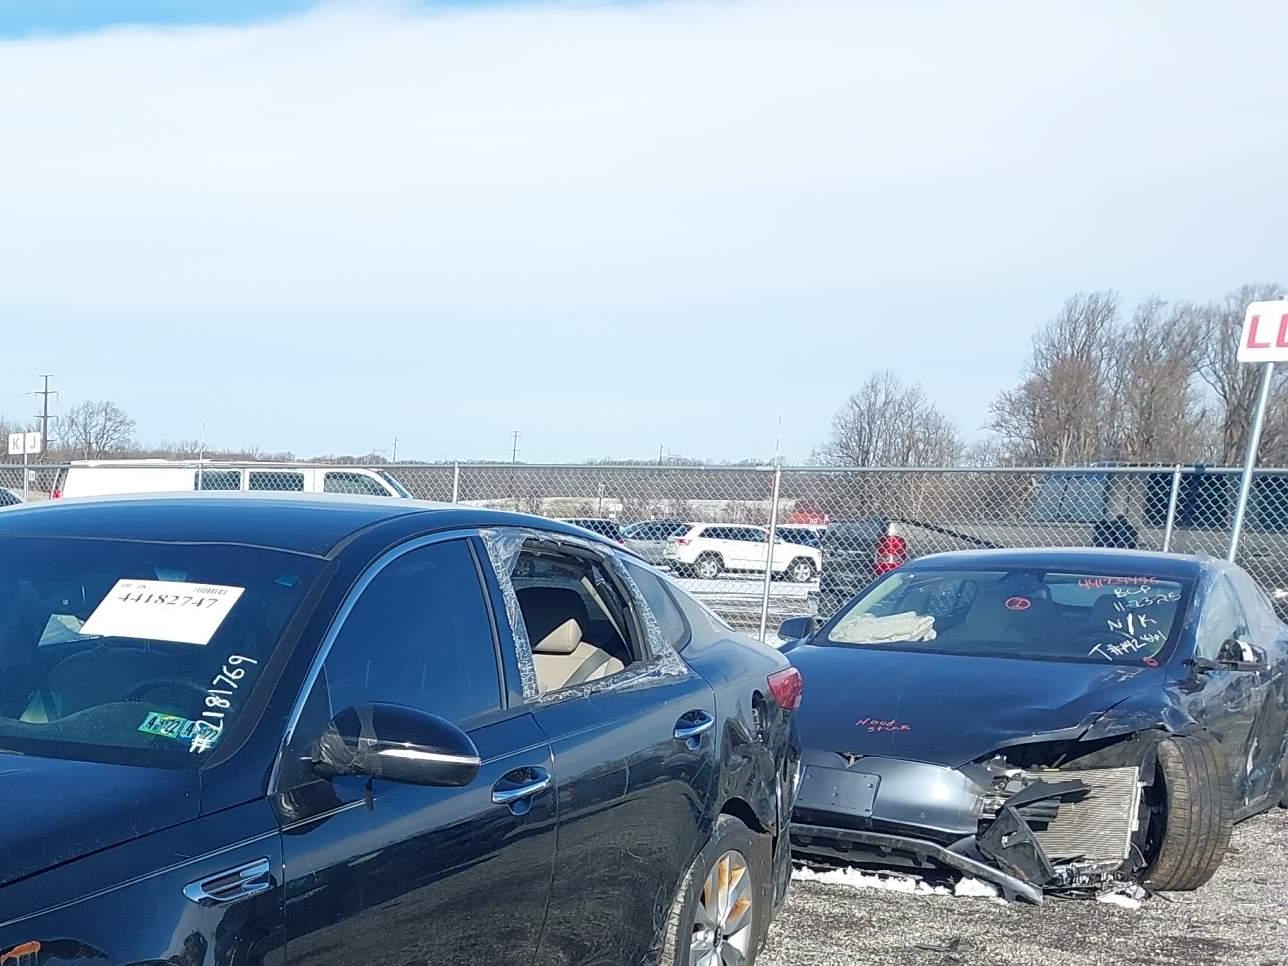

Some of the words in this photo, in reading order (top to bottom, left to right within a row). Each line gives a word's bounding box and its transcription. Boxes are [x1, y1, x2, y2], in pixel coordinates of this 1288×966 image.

[13, 437, 20, 450] K
[29, 435, 36, 450] J
[118, 592, 219, 609] 44182747
